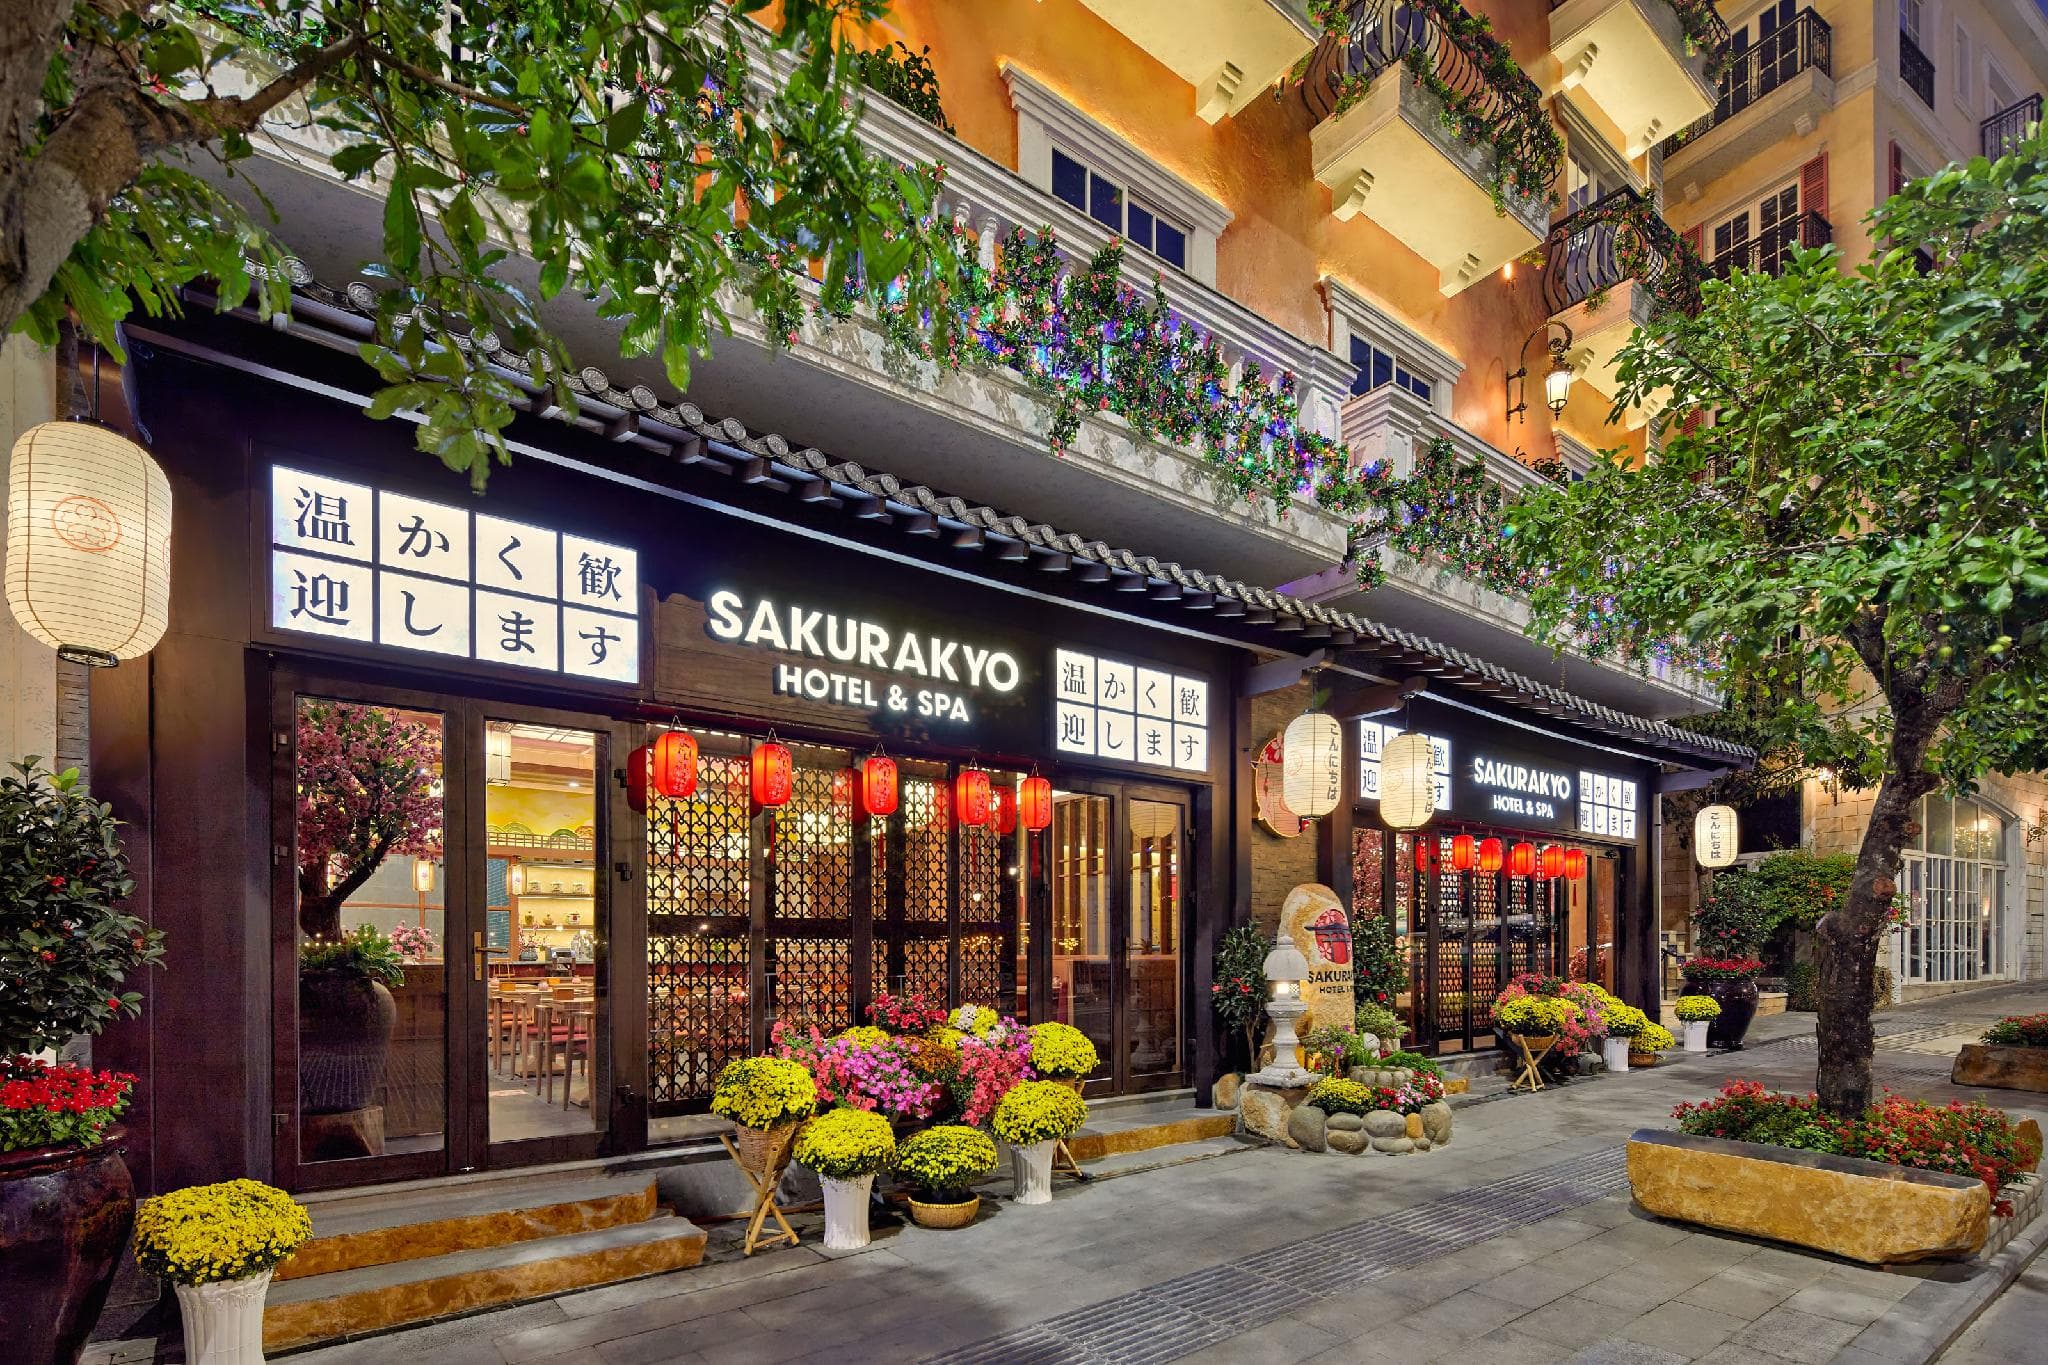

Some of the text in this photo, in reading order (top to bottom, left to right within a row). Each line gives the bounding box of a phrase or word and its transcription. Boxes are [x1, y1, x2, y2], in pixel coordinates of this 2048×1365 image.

[294, 486, 623, 603] 温かく歓
[291, 568, 621, 666] 迎します
[709, 590, 1020, 692] SAKURAKYO
[779, 663, 970, 722] HOTEL & SPA
[1063, 661, 1200, 717] 温かく歓
[1061, 711, 1199, 761] 迎します
[1327, 723, 1339, 801] こんにちは
[1474, 757, 1571, 800] SAKURAKYO
[1493, 794, 1554, 819] HOTEL & SPA
[1711, 812, 1721, 859] こんにちは
[1319, 985, 1345, 994] HOTEL
